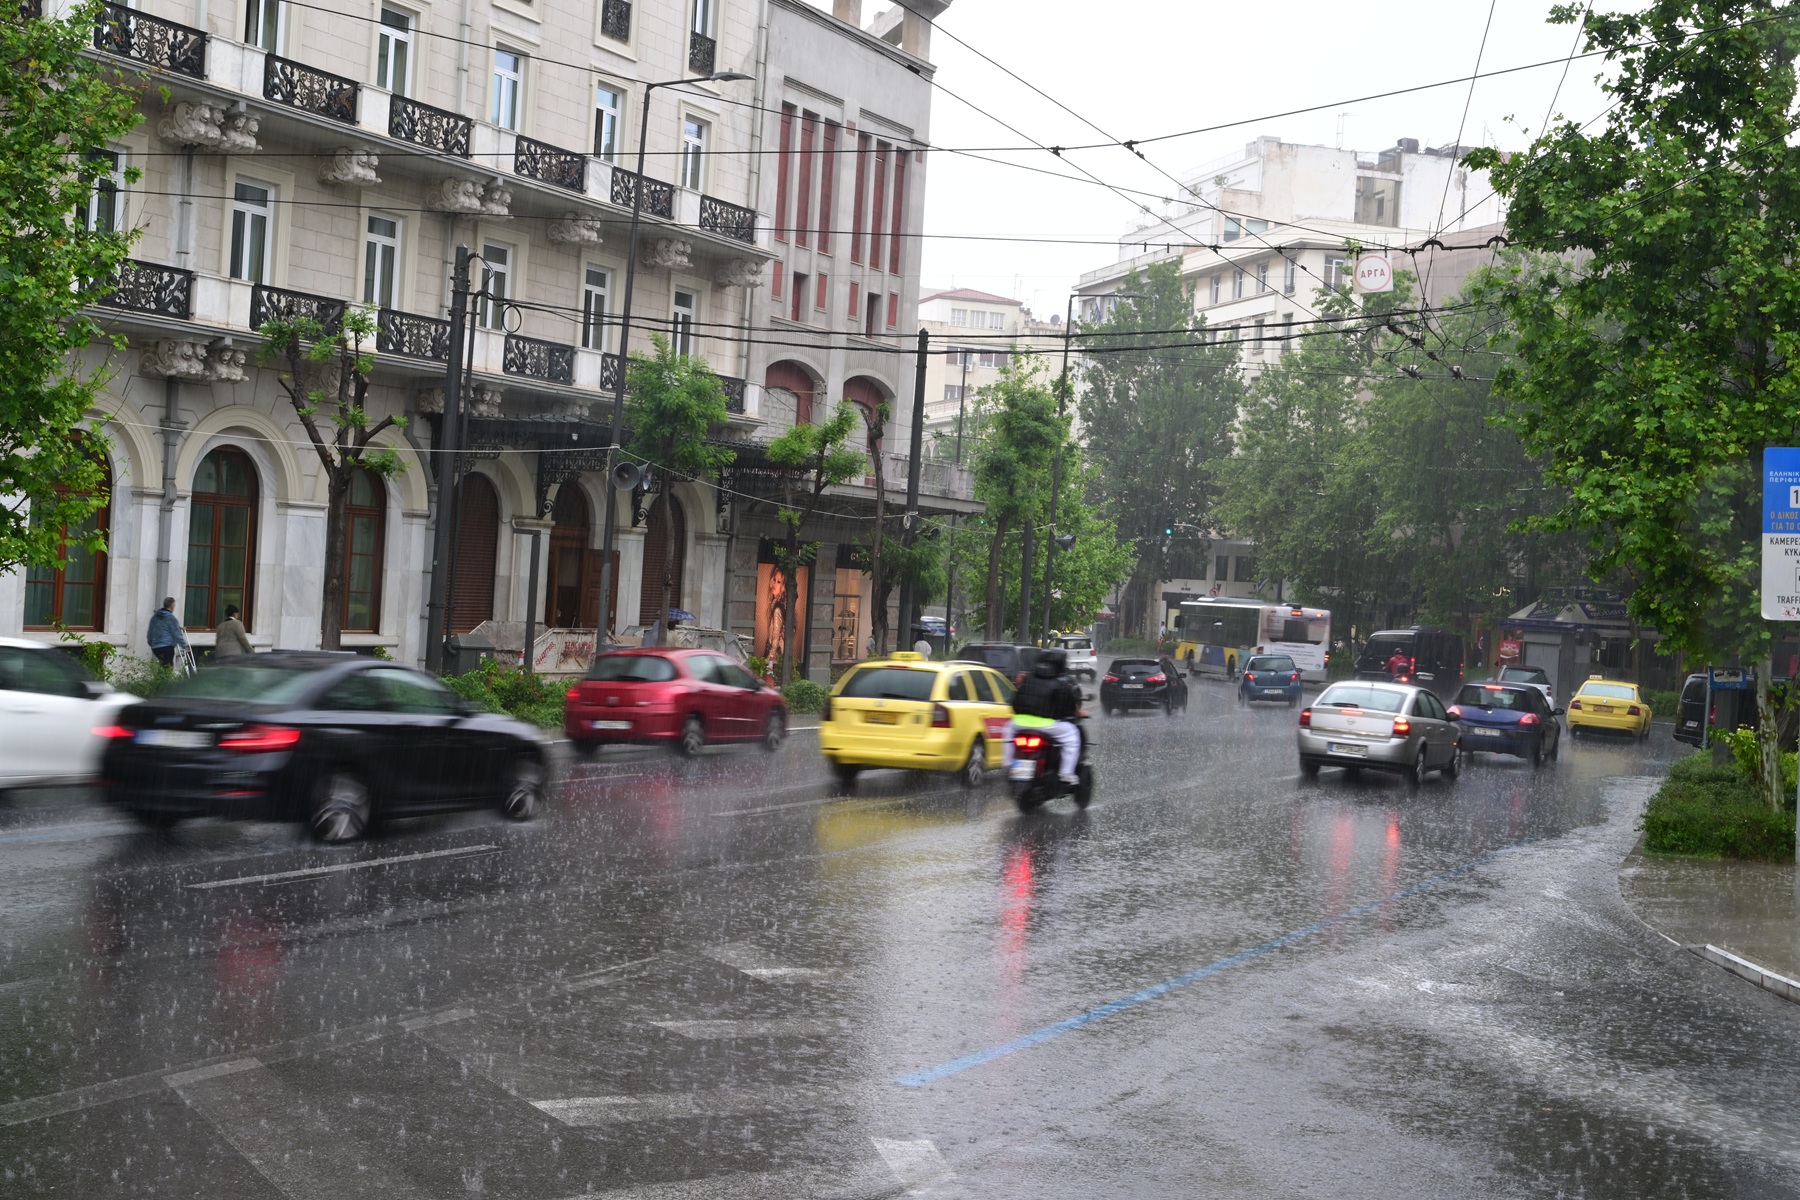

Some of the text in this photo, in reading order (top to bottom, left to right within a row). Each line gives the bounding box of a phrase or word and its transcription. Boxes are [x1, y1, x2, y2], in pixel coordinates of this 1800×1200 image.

[1361, 268, 1385, 278] ΑΡΓΑ
[1778, 511, 1799, 520] ΔΙΚΟΣ
[1771, 522, 1784, 530] ΓΙΑ
[1786, 522, 1795, 530] ΤΟ
